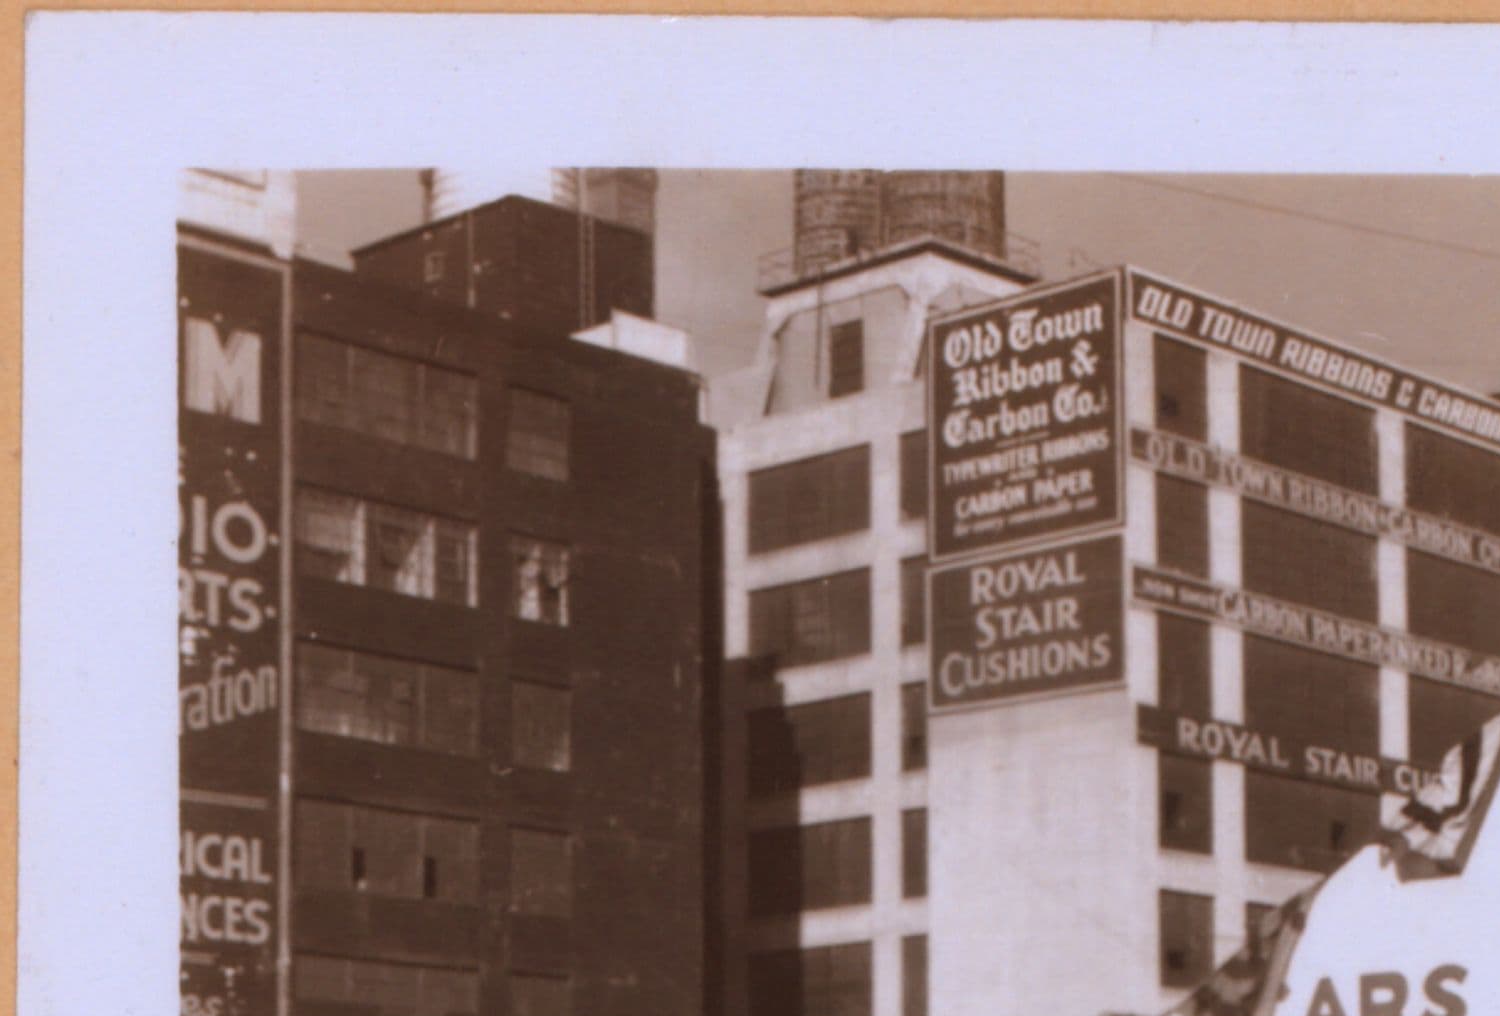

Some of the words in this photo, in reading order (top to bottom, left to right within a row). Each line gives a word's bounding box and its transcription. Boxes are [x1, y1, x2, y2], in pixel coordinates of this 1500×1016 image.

[943, 320, 1002, 368] Old
[1008, 303, 1104, 351] Town
[1137, 284, 1194, 330] OLD
[1198, 306, 1277, 360] TOWN
[1280, 335, 1393, 400] RIBBONS
[953, 356, 1063, 406] Ribbon
[1070, 339, 1100, 378] &
[942, 401, 1049, 447] Carbon
[955, 484, 1027, 521] CARBON
[1031, 468, 1094, 502] PAPER
[970, 551, 1087, 605] ROYAL
[975, 596, 1082, 649] STAIR
[939, 632, 1112, 697] CUSHIONS
[1176, 717, 1290, 769] ROYAL
[1304, 745, 1380, 786] STAIR
